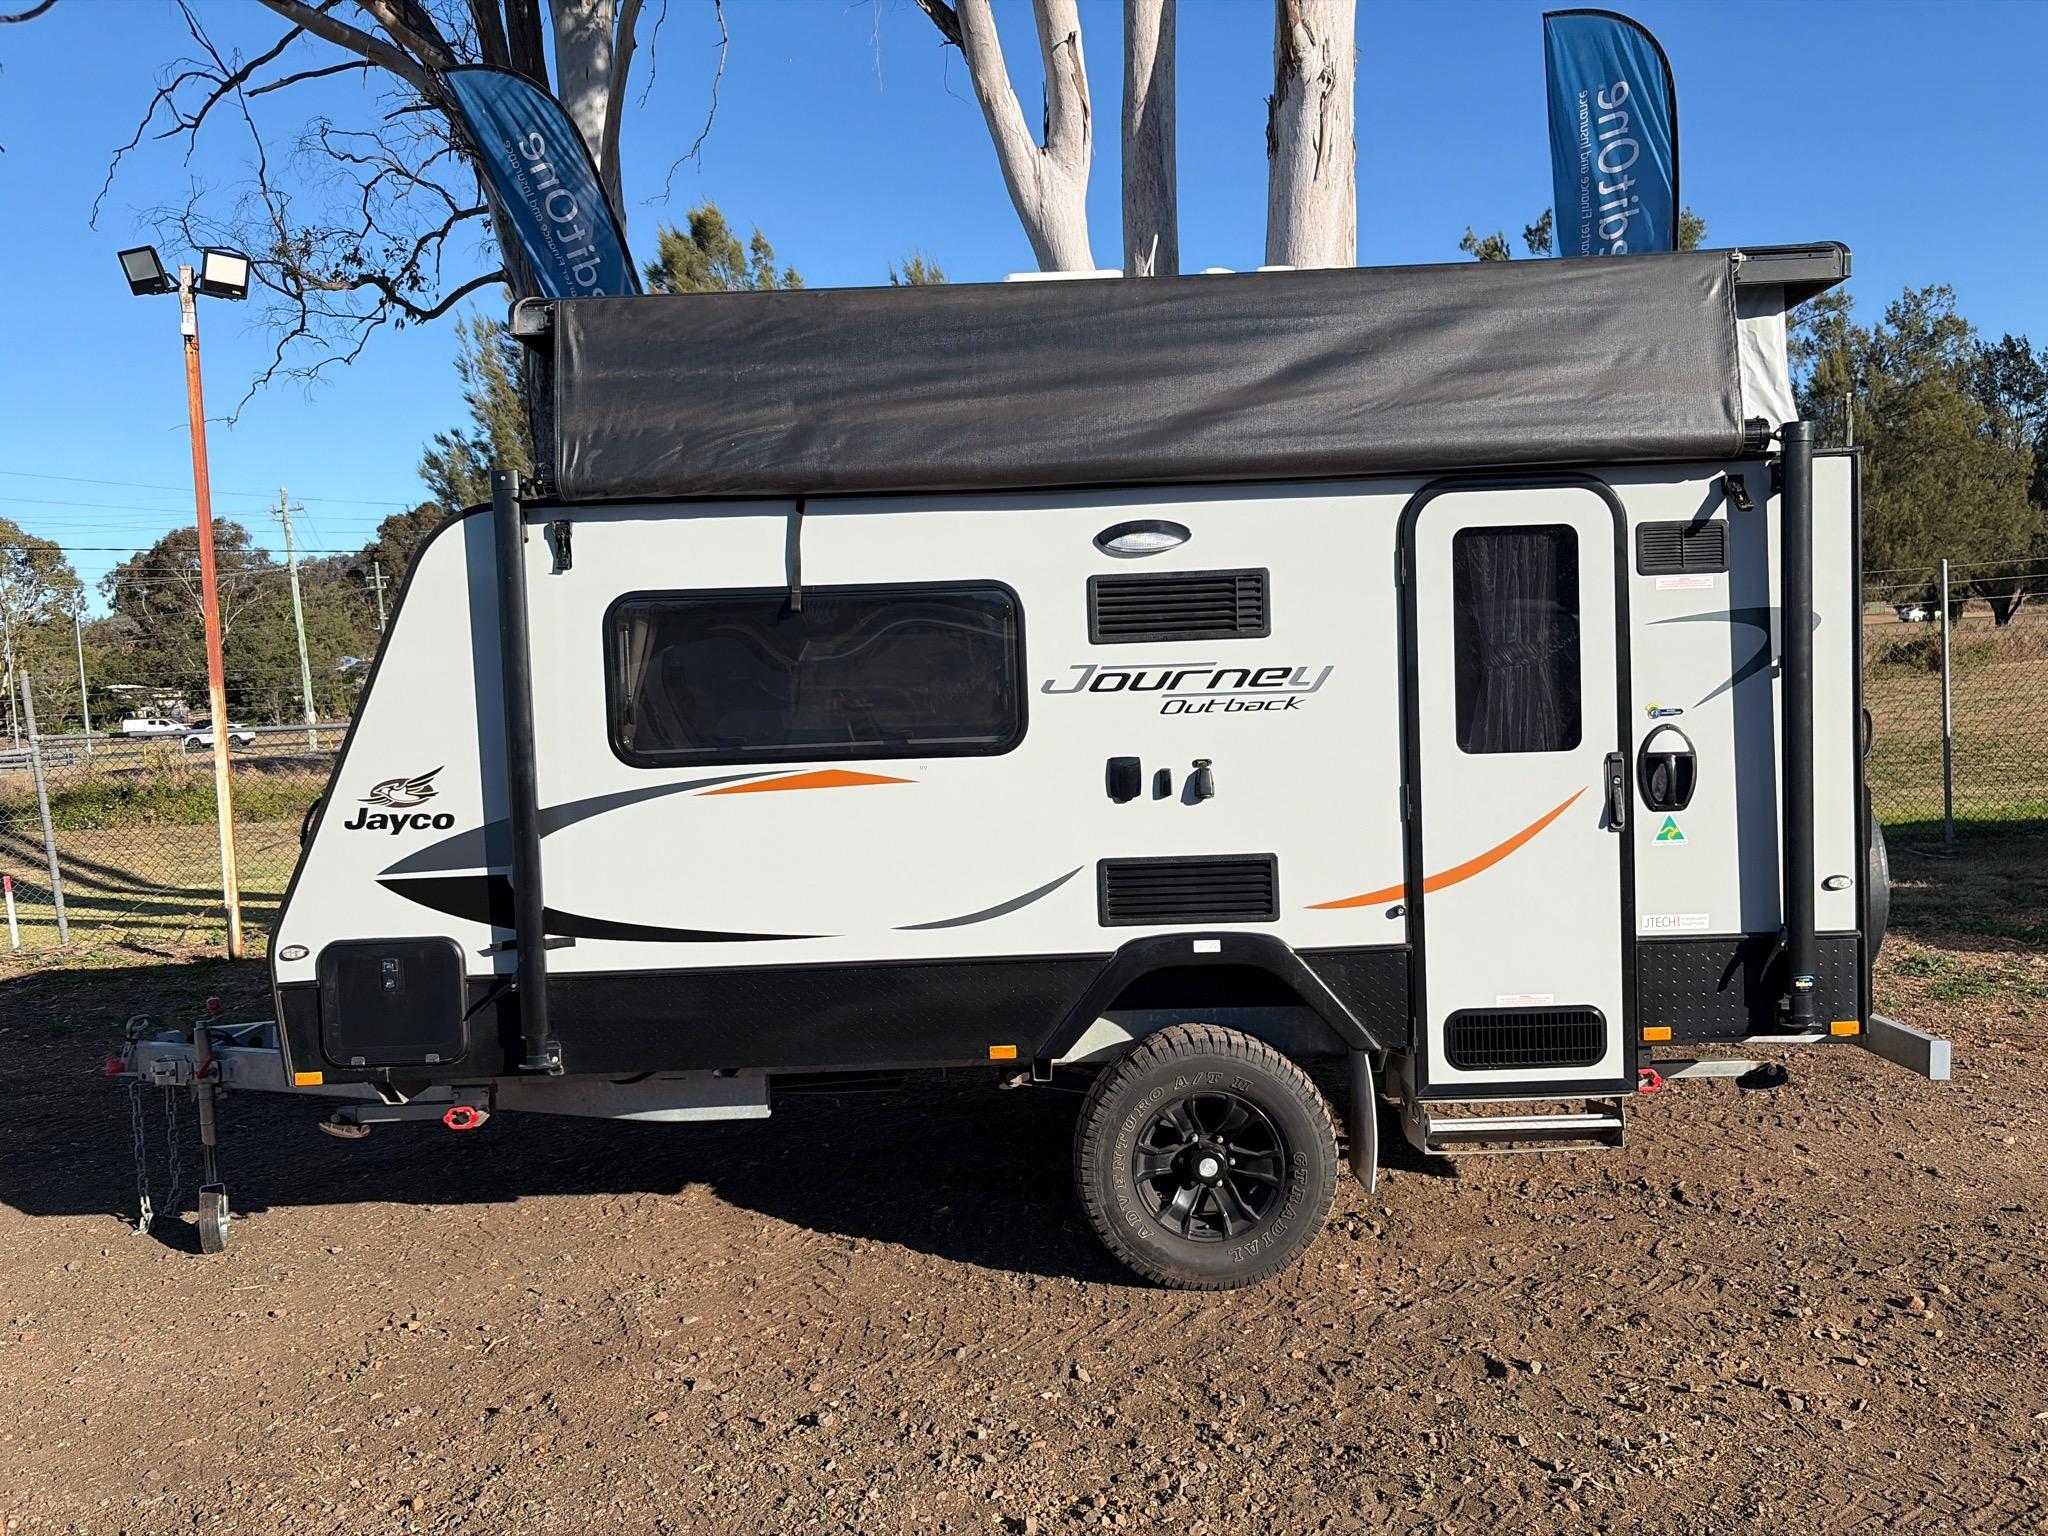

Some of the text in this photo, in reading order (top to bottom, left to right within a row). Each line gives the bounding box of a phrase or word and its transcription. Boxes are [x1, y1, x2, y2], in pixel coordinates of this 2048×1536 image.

[1040, 663, 1334, 695] Journey
[1160, 696, 1306, 715] Outback
[344, 807, 455, 836] Jayco
[1112, 1086, 1165, 1239] ADVENTURO
[1173, 1071, 1223, 1091] A/T
